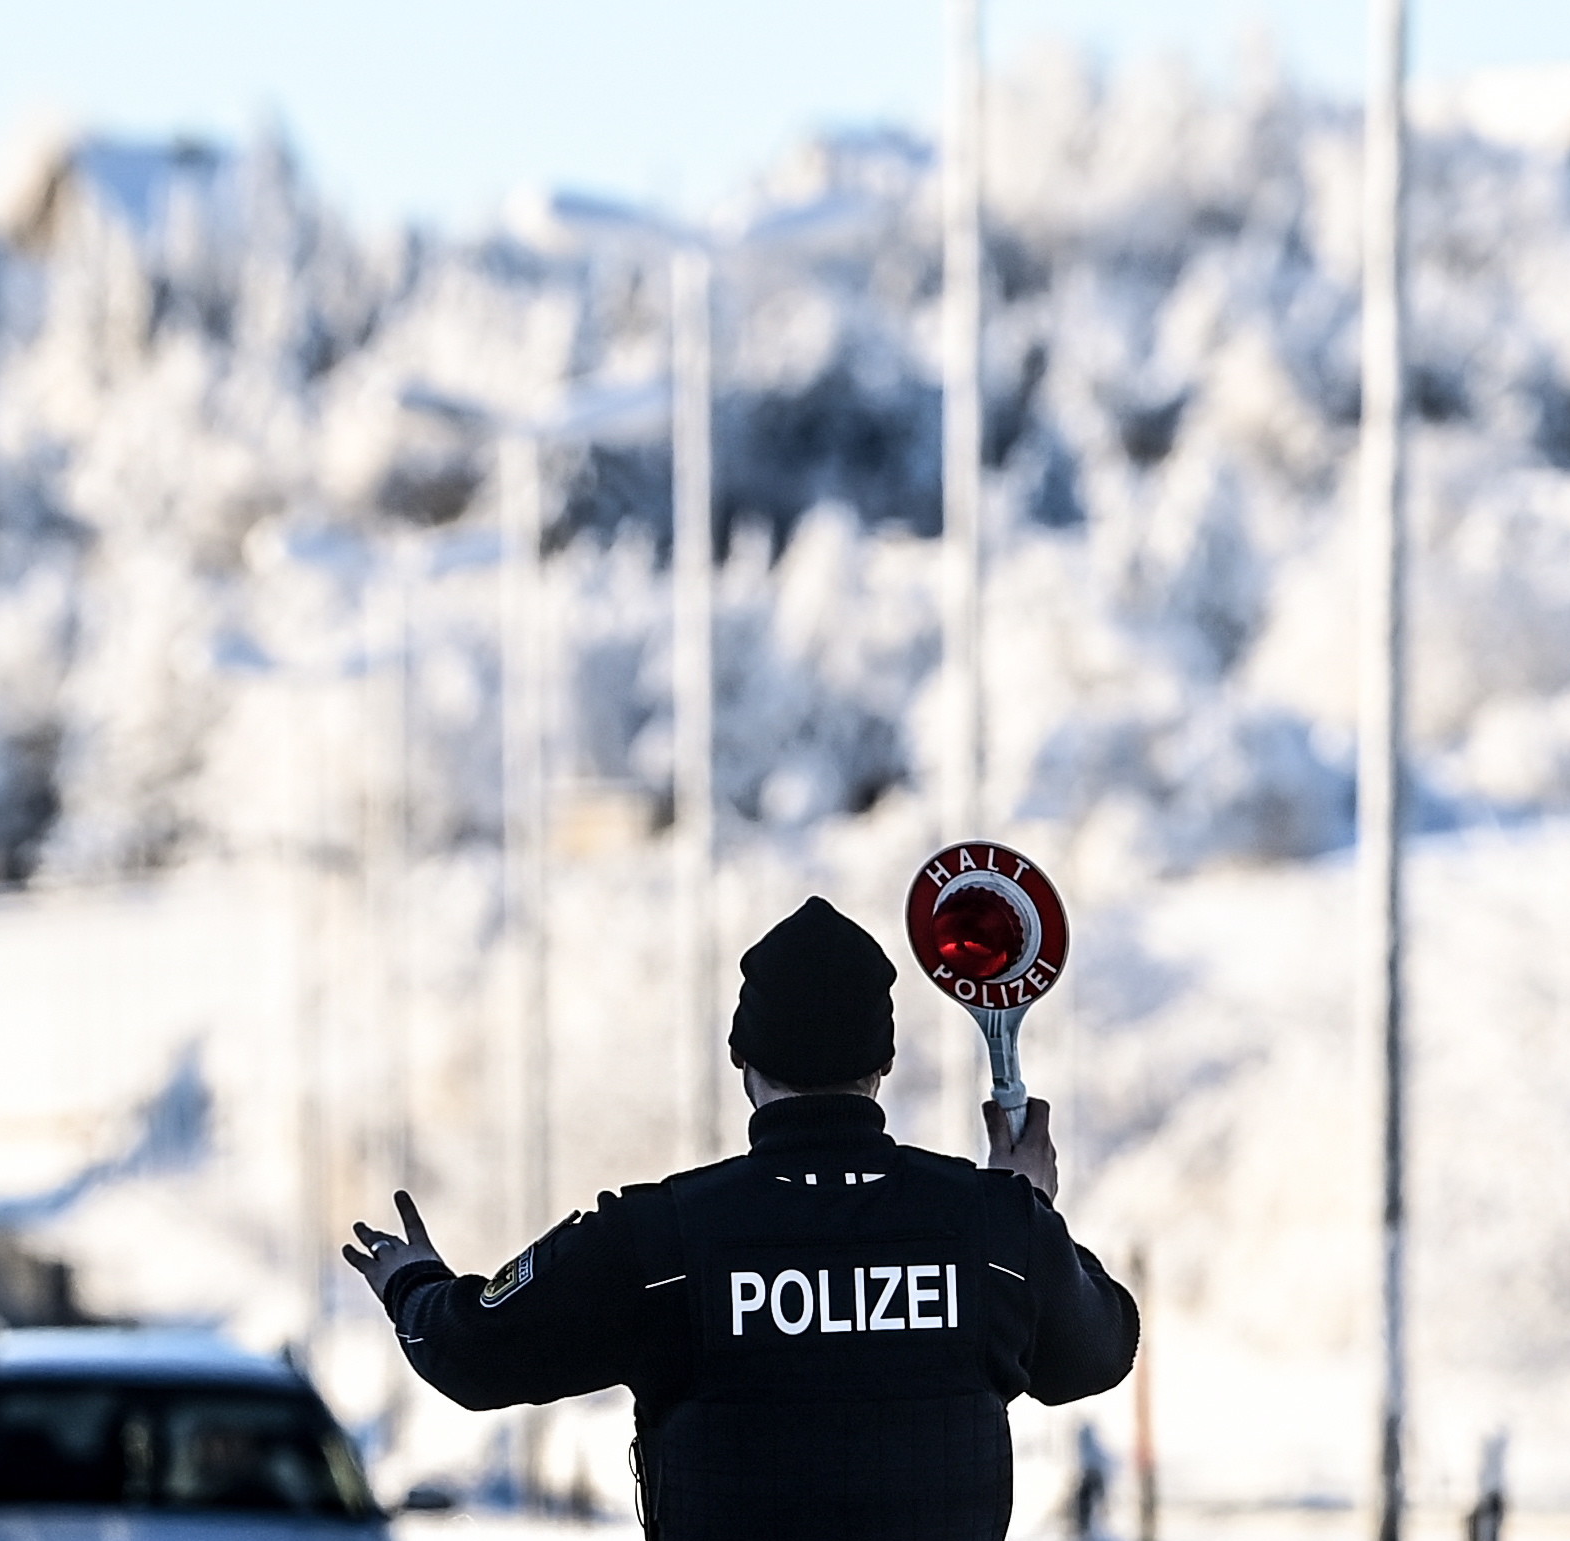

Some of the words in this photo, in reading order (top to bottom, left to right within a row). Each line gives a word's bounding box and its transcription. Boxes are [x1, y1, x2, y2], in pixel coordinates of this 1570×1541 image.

[925, 847, 1030, 888] HALT
[932, 957, 1057, 1008] POLIZEI
[730, 1263, 958, 1336] POLIZEI
